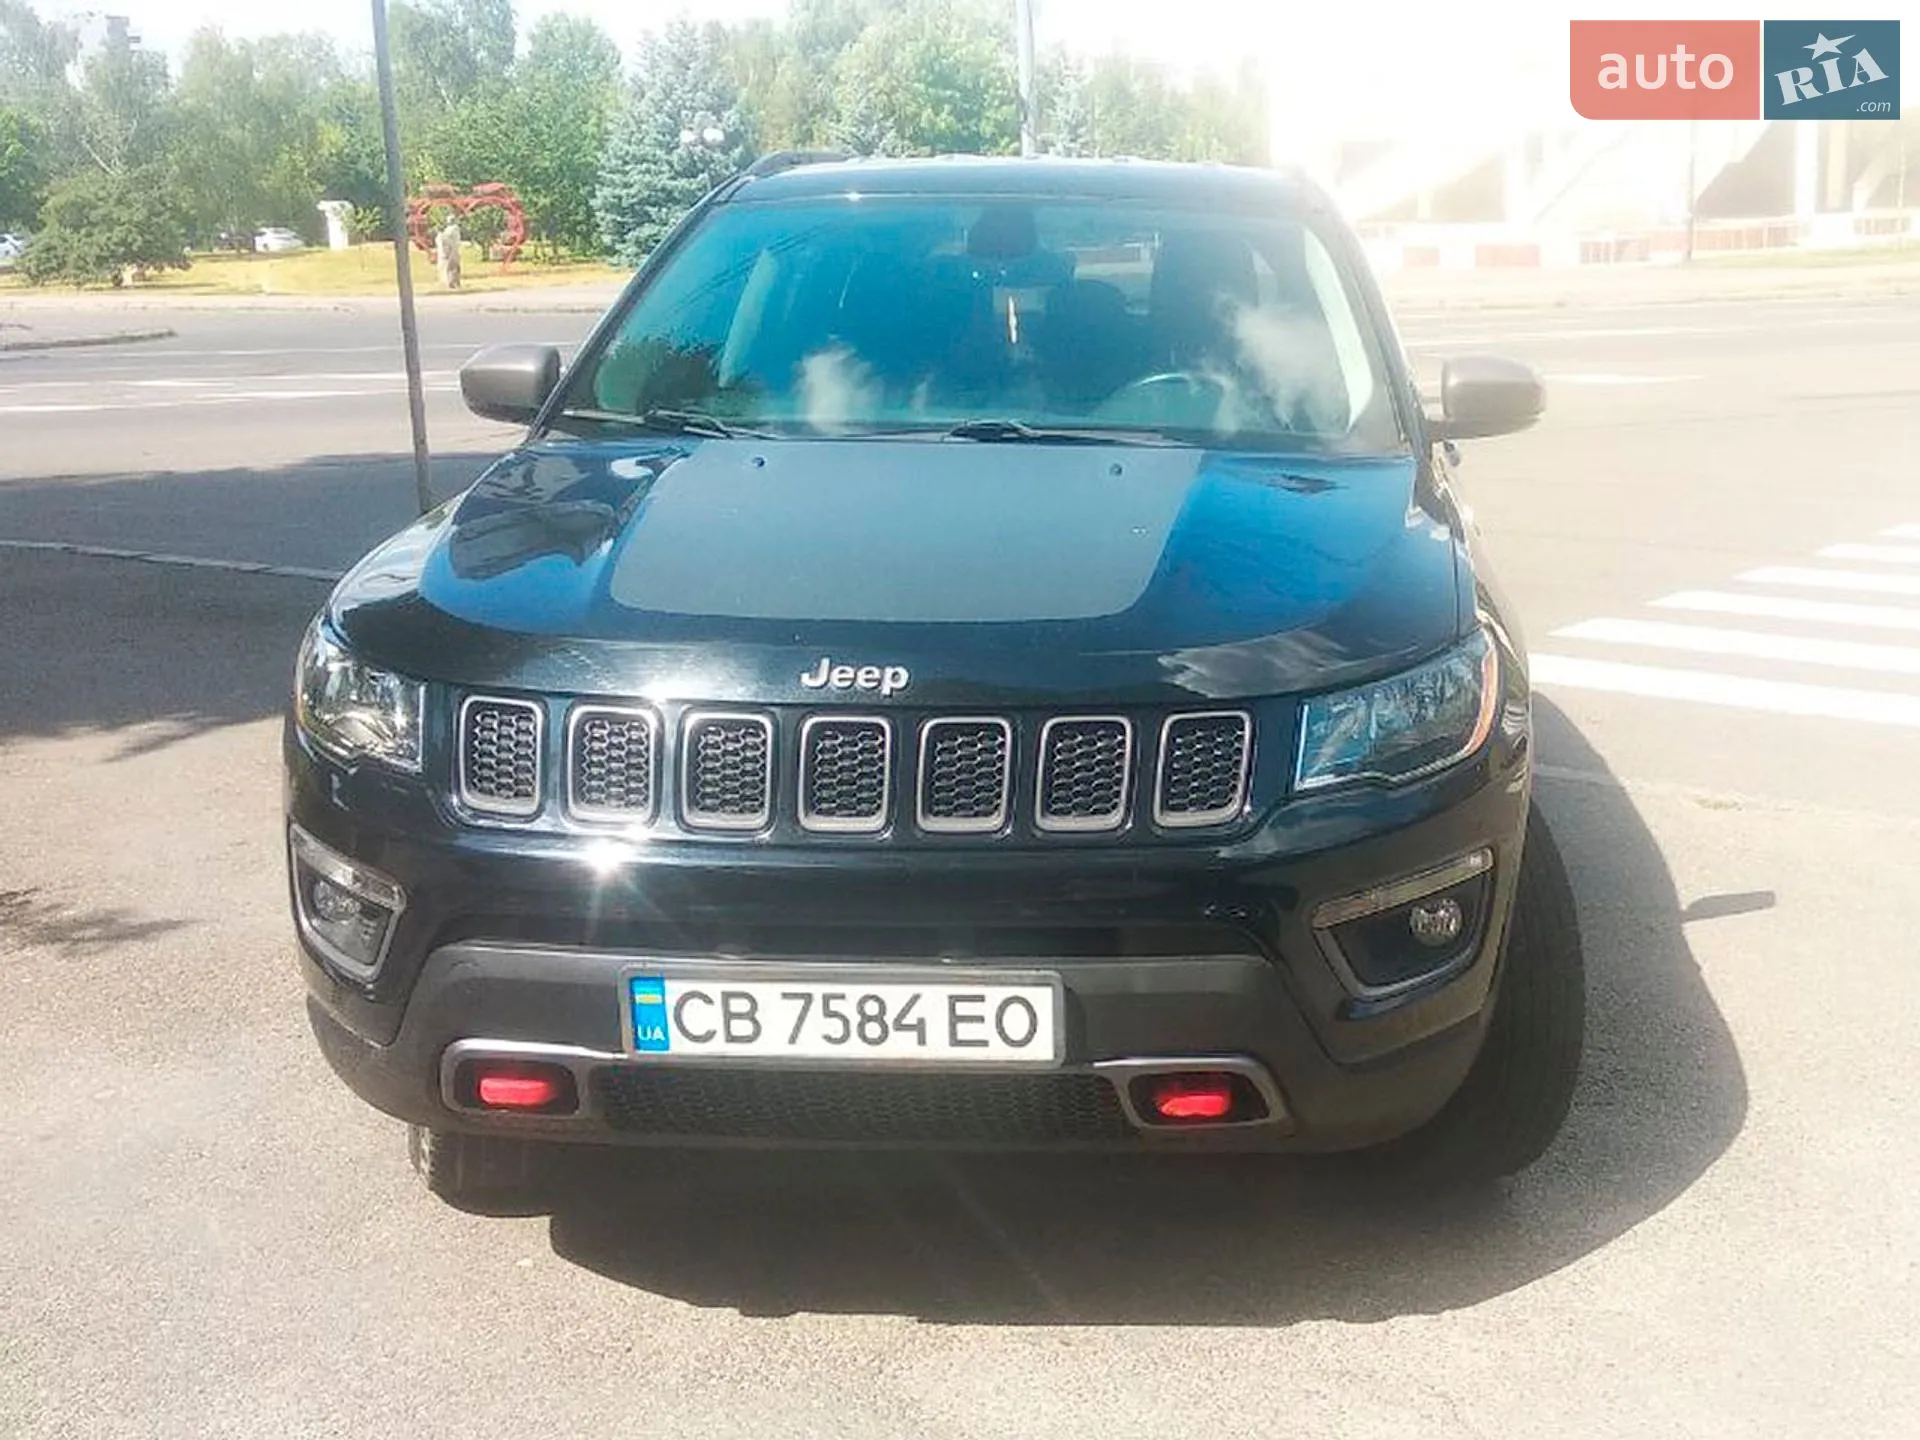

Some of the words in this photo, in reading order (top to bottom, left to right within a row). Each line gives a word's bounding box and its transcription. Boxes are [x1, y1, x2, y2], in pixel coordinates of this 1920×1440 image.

[801, 657, 909, 695] Jeep
[637, 1025, 665, 1042] UA
[673, 990, 762, 1044] CB
[780, 992, 927, 1047] 7584
[946, 994, 1038, 1049] EO
